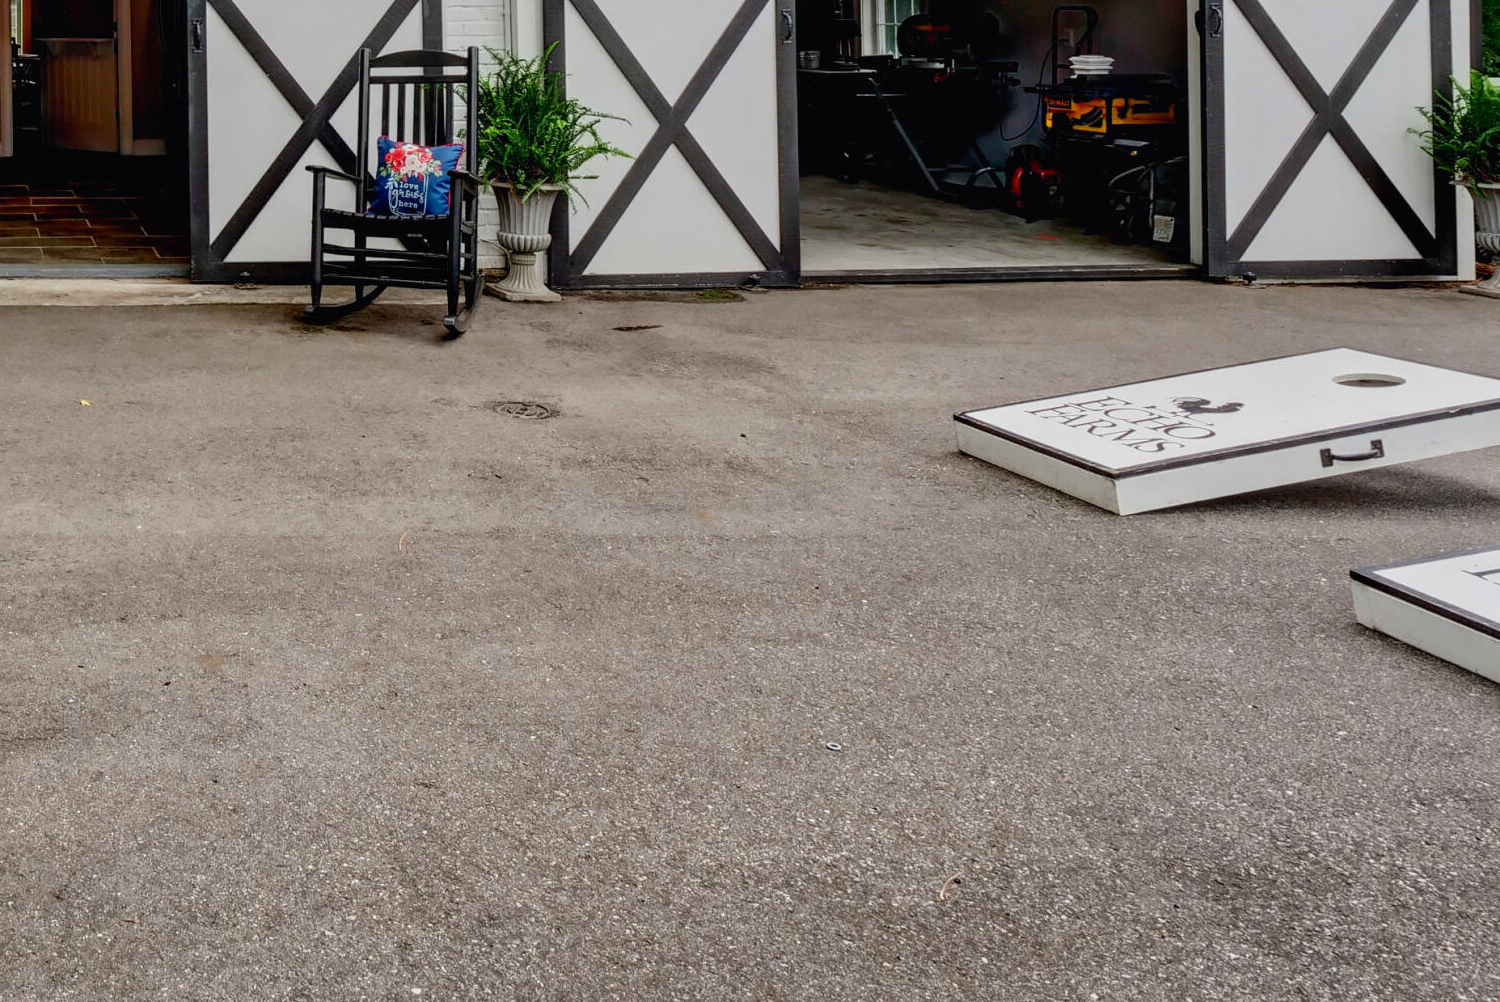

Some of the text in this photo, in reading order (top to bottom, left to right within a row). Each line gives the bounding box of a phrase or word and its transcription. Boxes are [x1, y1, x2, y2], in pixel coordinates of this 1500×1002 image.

[399, 181, 419, 190] love
[391, 188, 424, 209] grows
[398, 199, 418, 209] here
[1024, 403, 1185, 453] FARMS
[1070, 396, 1216, 440] ECHO
